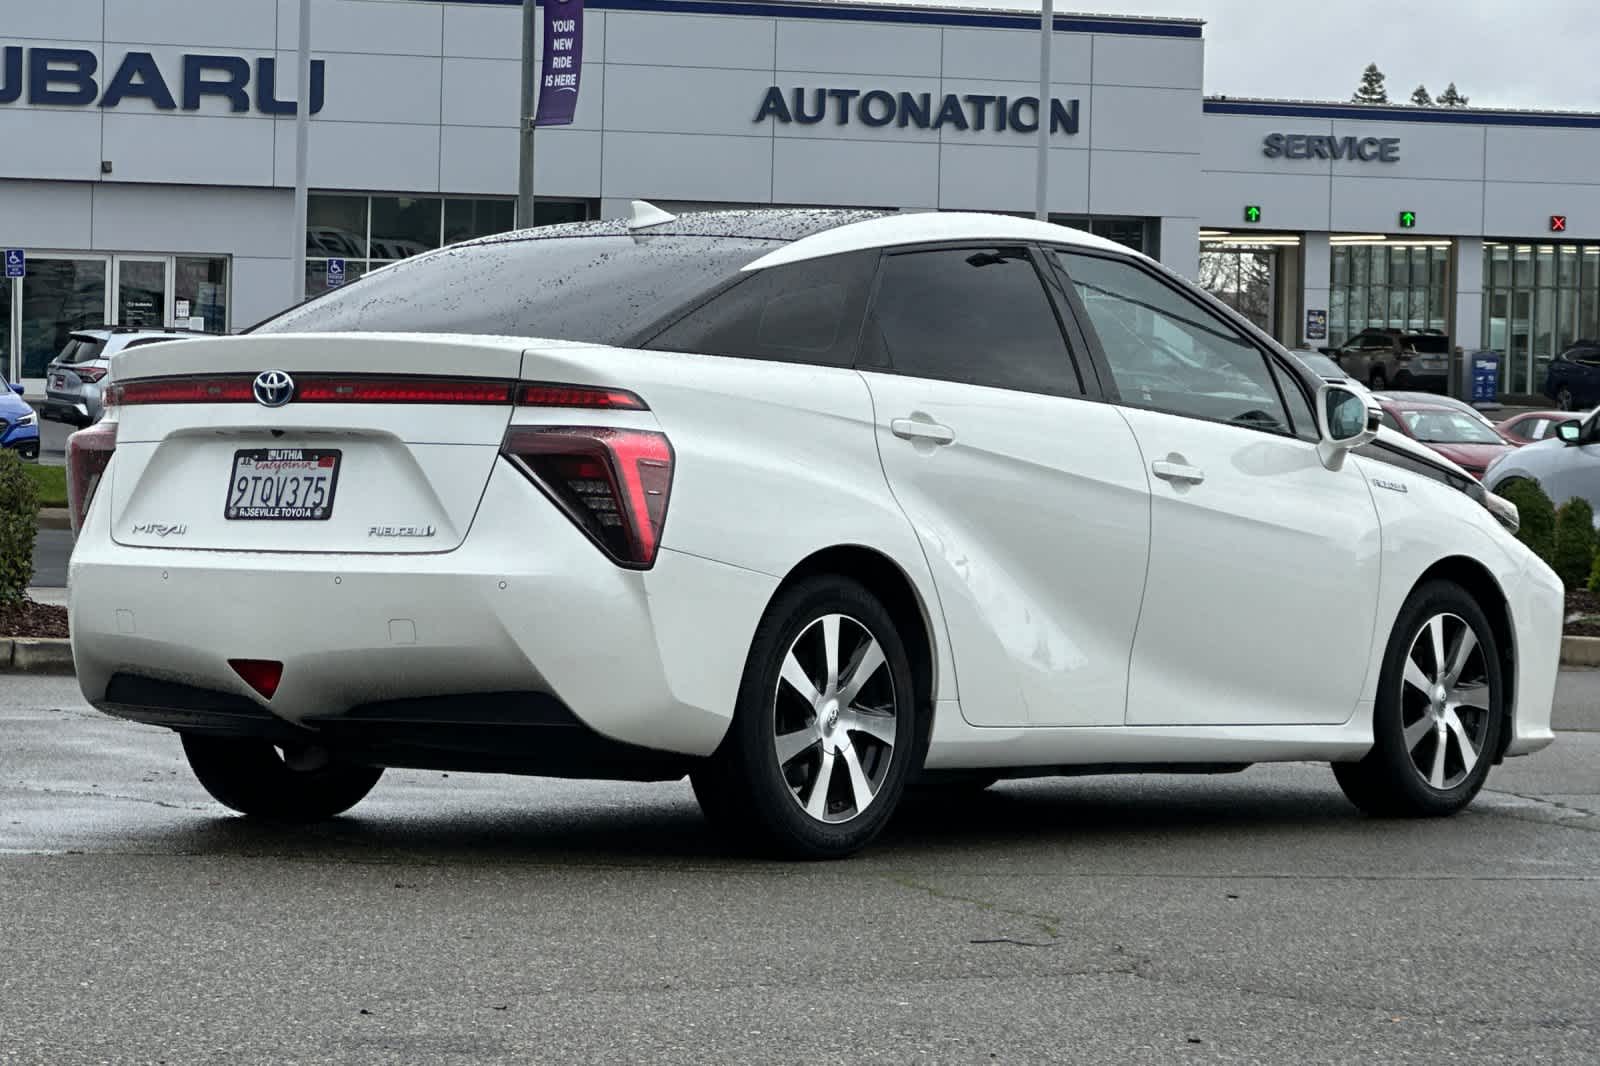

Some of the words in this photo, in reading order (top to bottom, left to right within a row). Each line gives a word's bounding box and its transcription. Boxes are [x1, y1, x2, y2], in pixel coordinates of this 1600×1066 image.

[552, 20, 575, 32] YOUR
[553, 38, 573, 50] NEW
[552, 56, 572, 68] RIDE
[545, 74, 554, 87] IS
[554, 74, 576, 86] HERE
[753, 86, 1079, 135] AUTONATION
[1263, 133, 1401, 163] SERVICE
[232, 476, 327, 508] 9TQV375
[281, 508, 312, 518] TOYOTA
